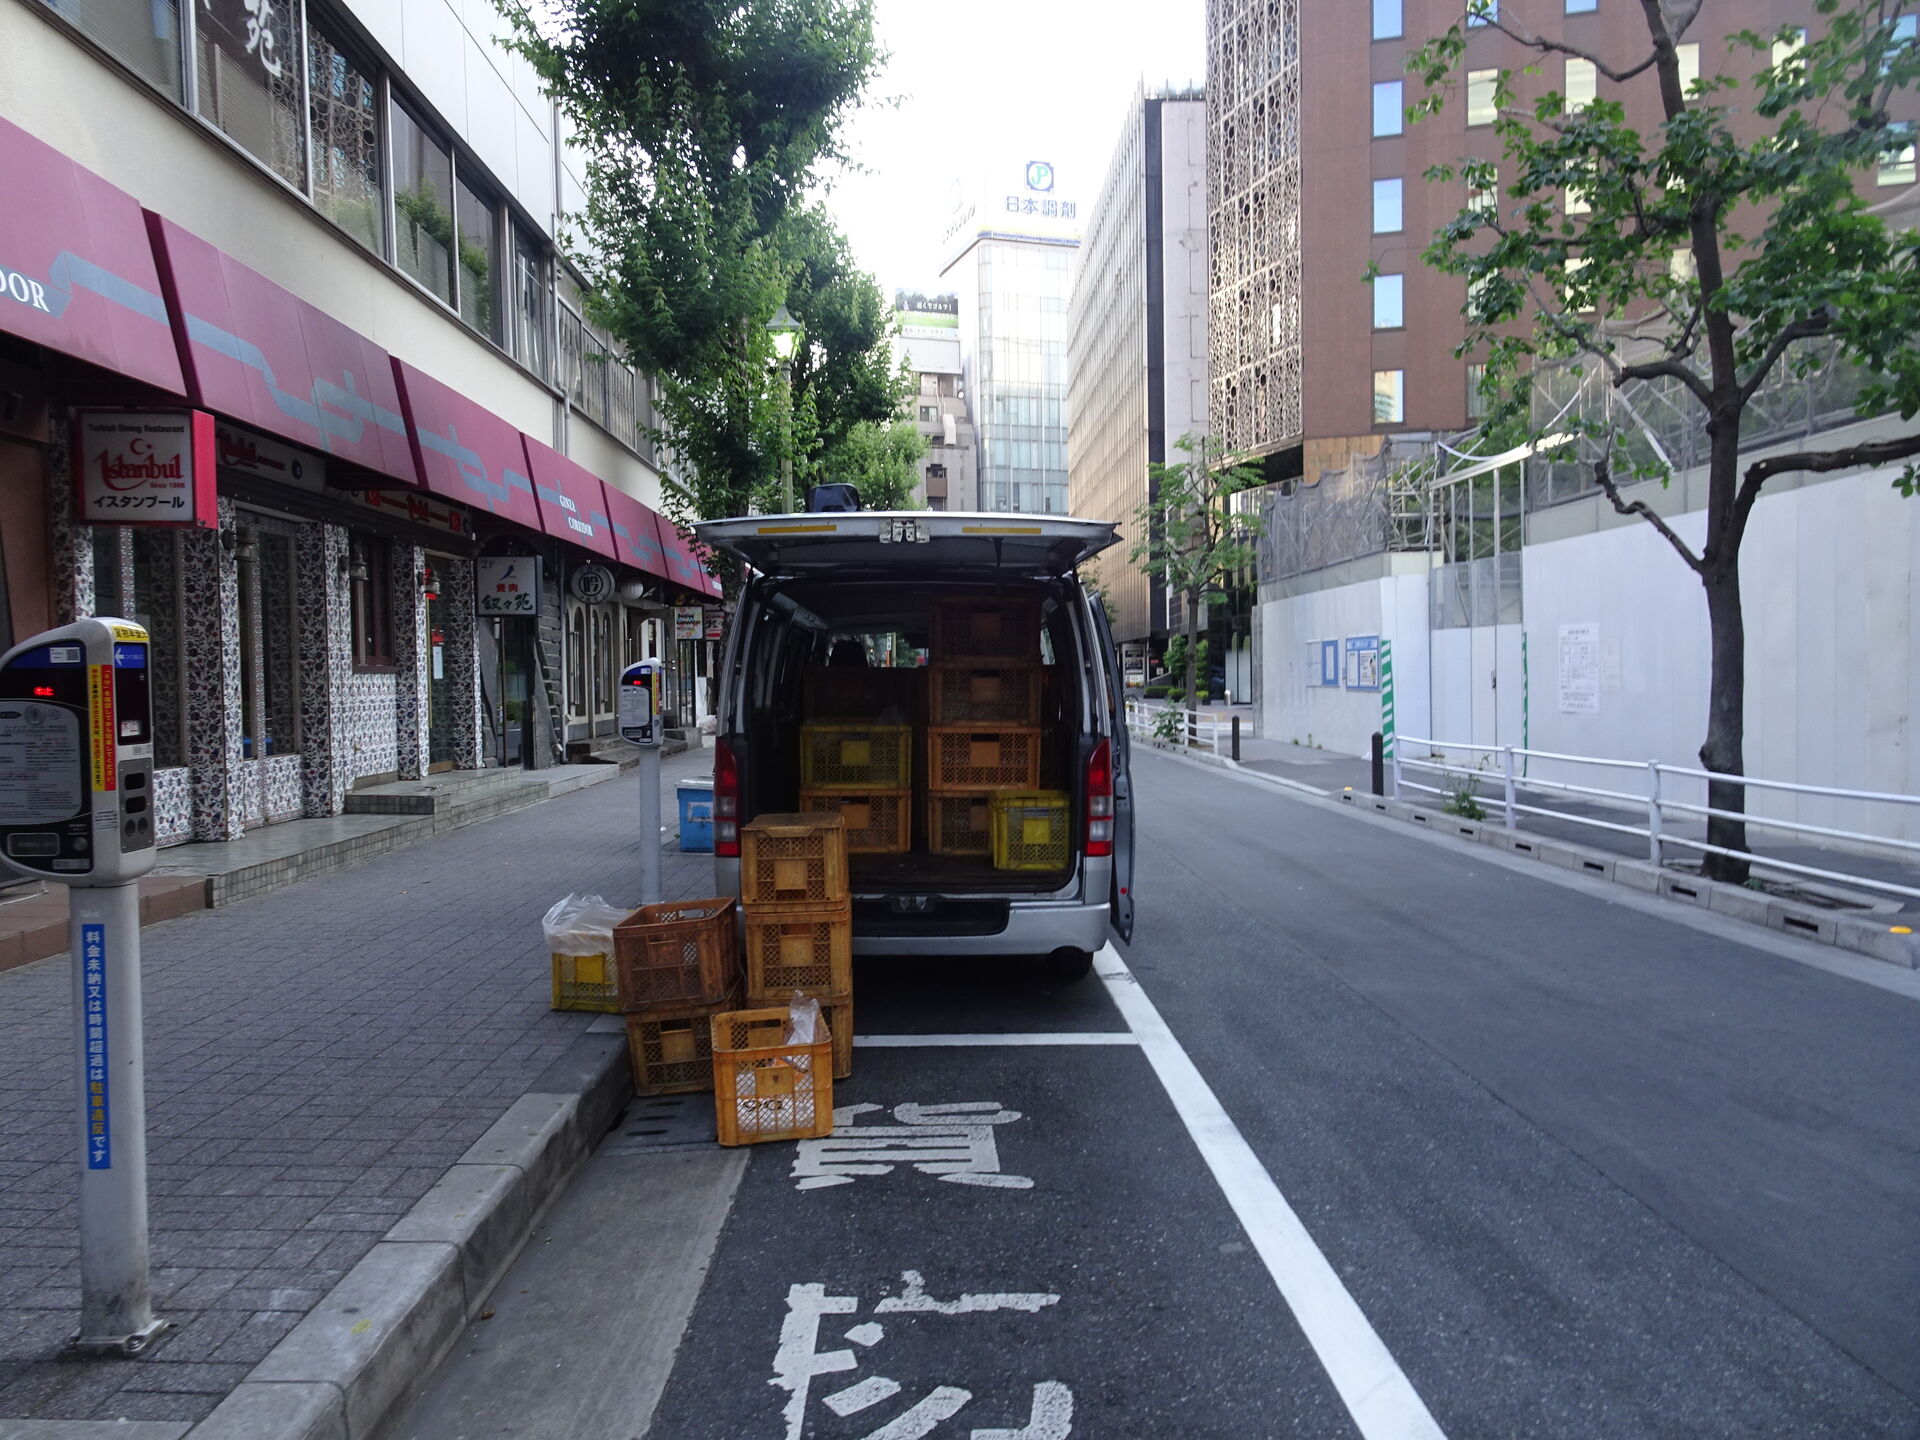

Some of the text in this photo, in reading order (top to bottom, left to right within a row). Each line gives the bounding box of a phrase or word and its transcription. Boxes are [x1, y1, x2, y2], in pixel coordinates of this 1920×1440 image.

[1006, 195, 1077, 219] 日本調剤
[144, 424, 185, 433] Restaurant
[92, 449, 184, 491] Istanbul
[93, 495, 185, 508] イスタンブール
[559, 494, 577, 513] GINZA
[568, 516, 594, 537] CORRIDOR
[85, 930, 107, 1163] 料金未納又は時間超過は駐車違反です
